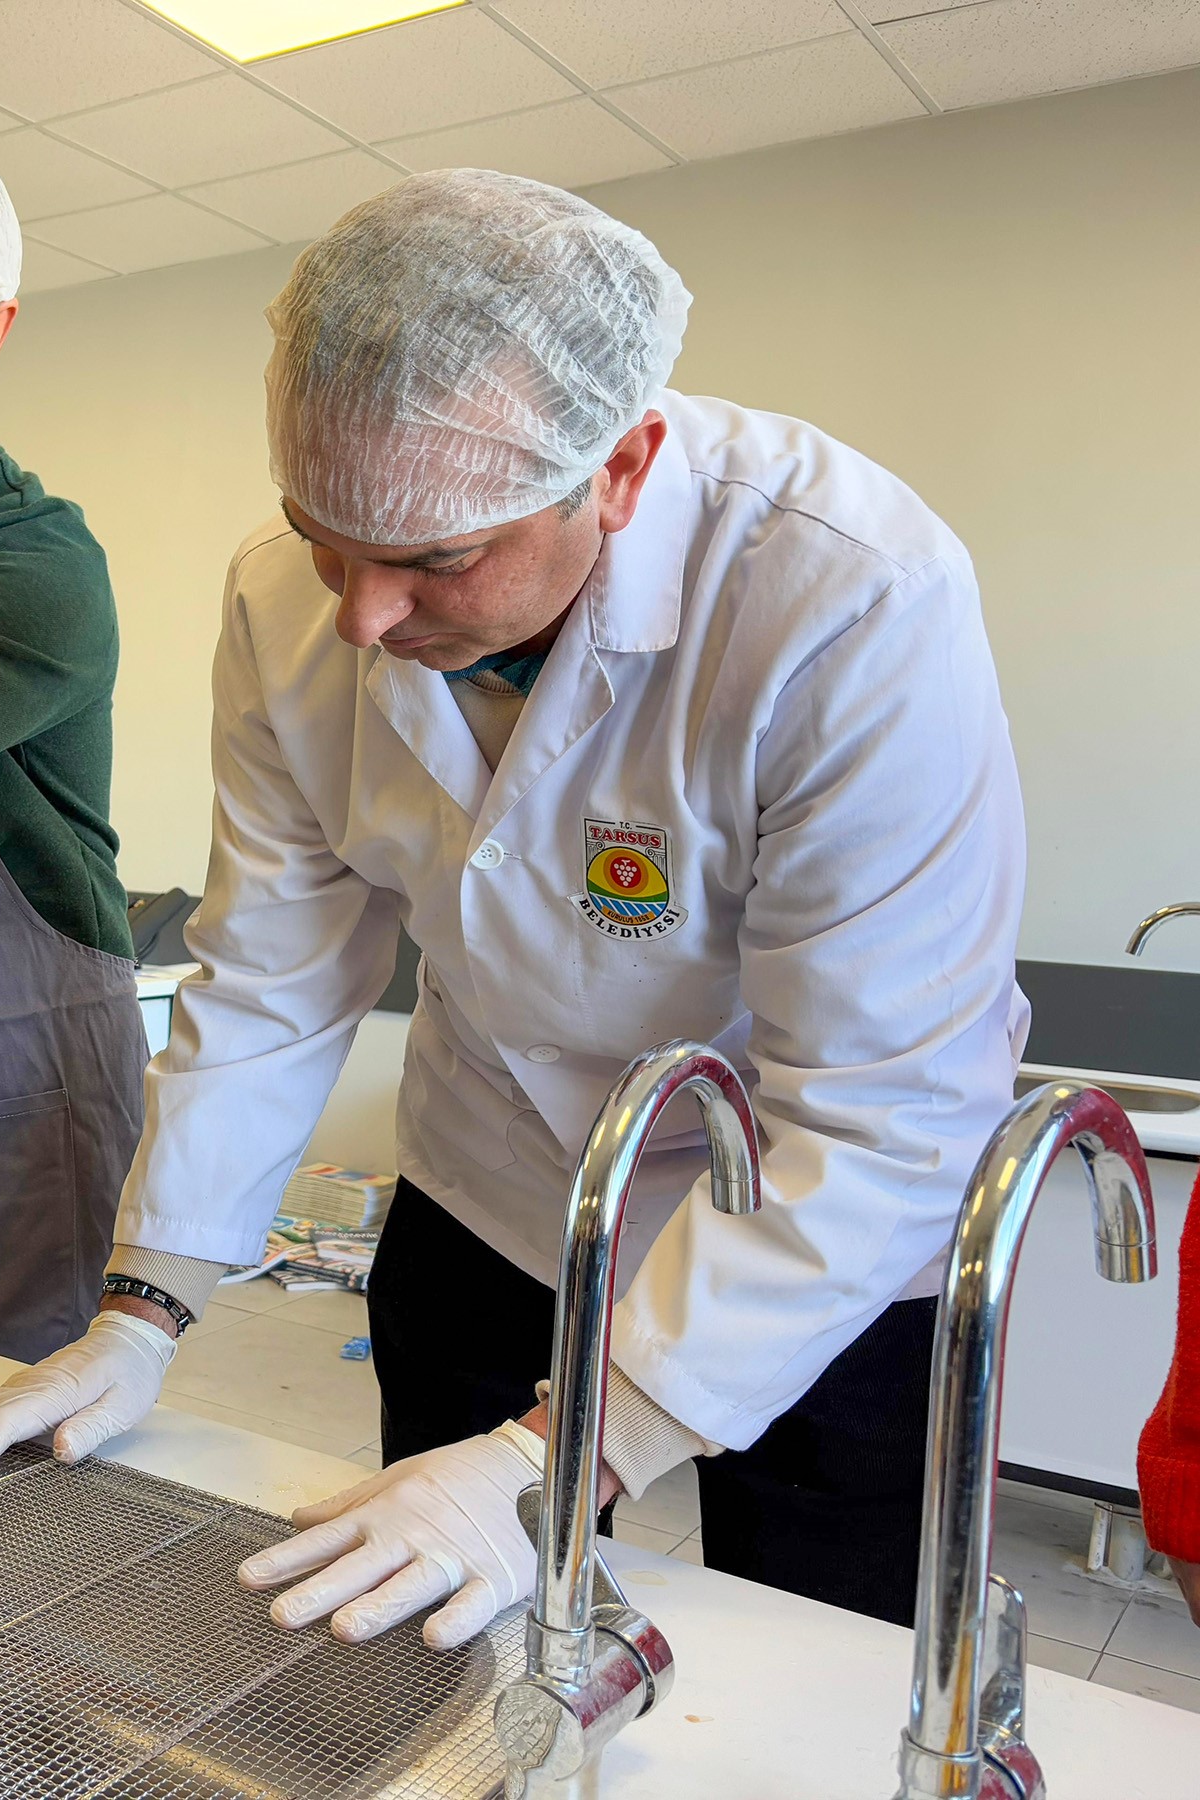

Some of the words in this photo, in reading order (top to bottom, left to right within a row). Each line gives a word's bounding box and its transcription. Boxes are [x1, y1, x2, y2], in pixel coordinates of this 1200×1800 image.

[619, 821, 632, 830] T.C.
[589, 826, 661, 848] TARSUS
[580, 898, 680, 938] BELEDİYESİ
